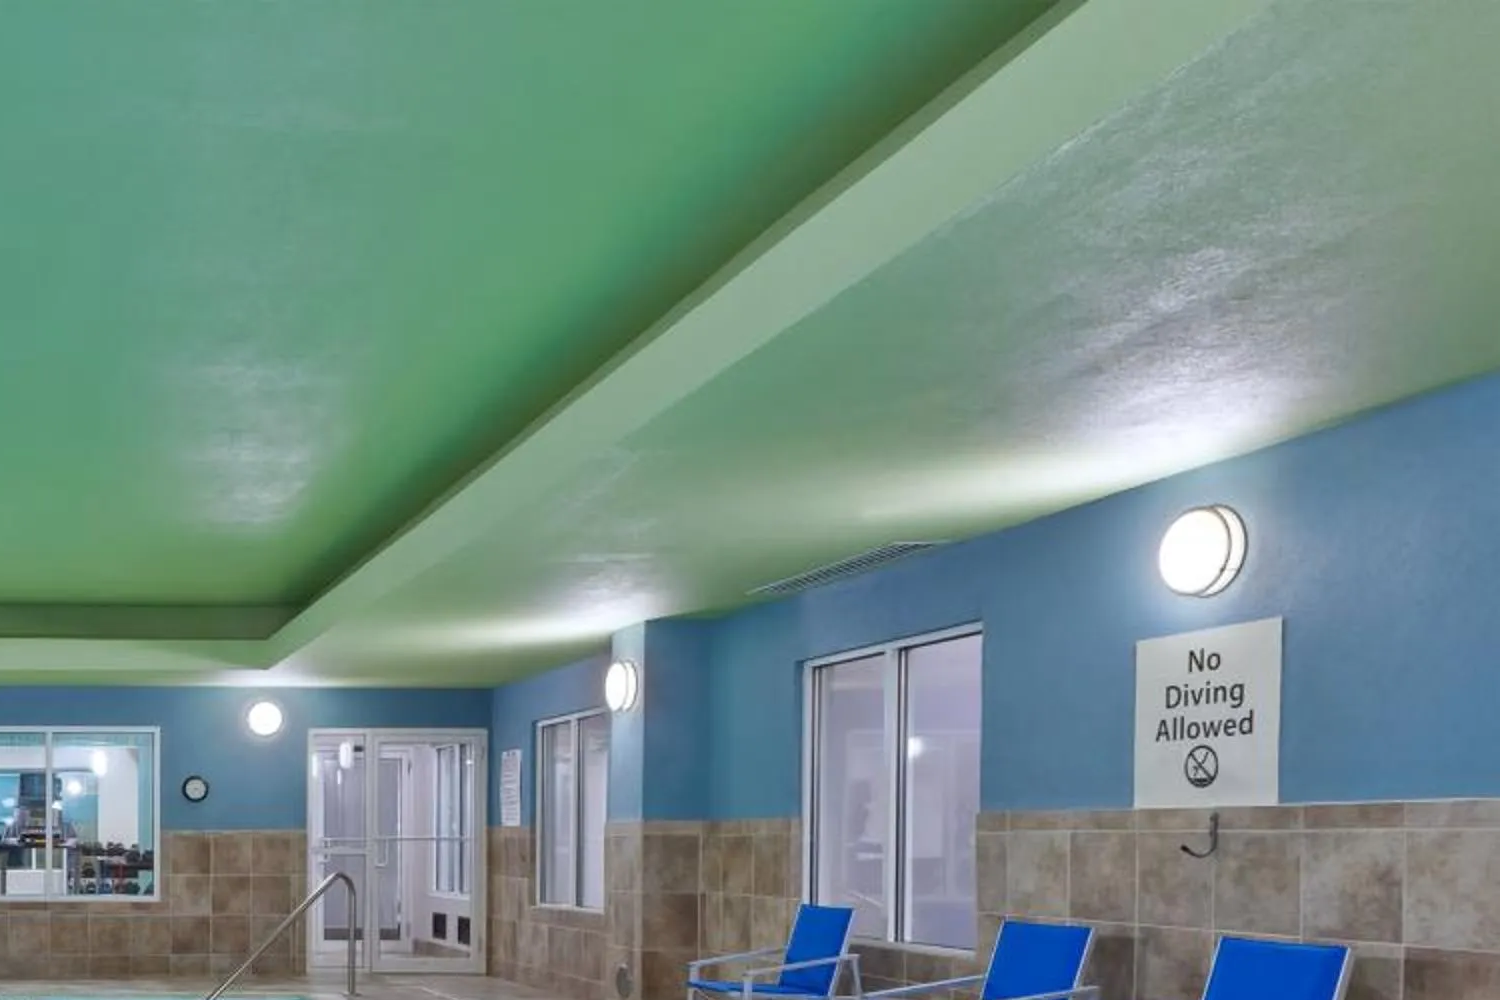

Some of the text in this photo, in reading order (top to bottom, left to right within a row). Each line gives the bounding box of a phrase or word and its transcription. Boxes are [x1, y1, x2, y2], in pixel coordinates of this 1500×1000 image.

[1187, 648, 1222, 673] No
[1165, 680, 1245, 709] Diving
[1155, 709, 1254, 743] Allowed
